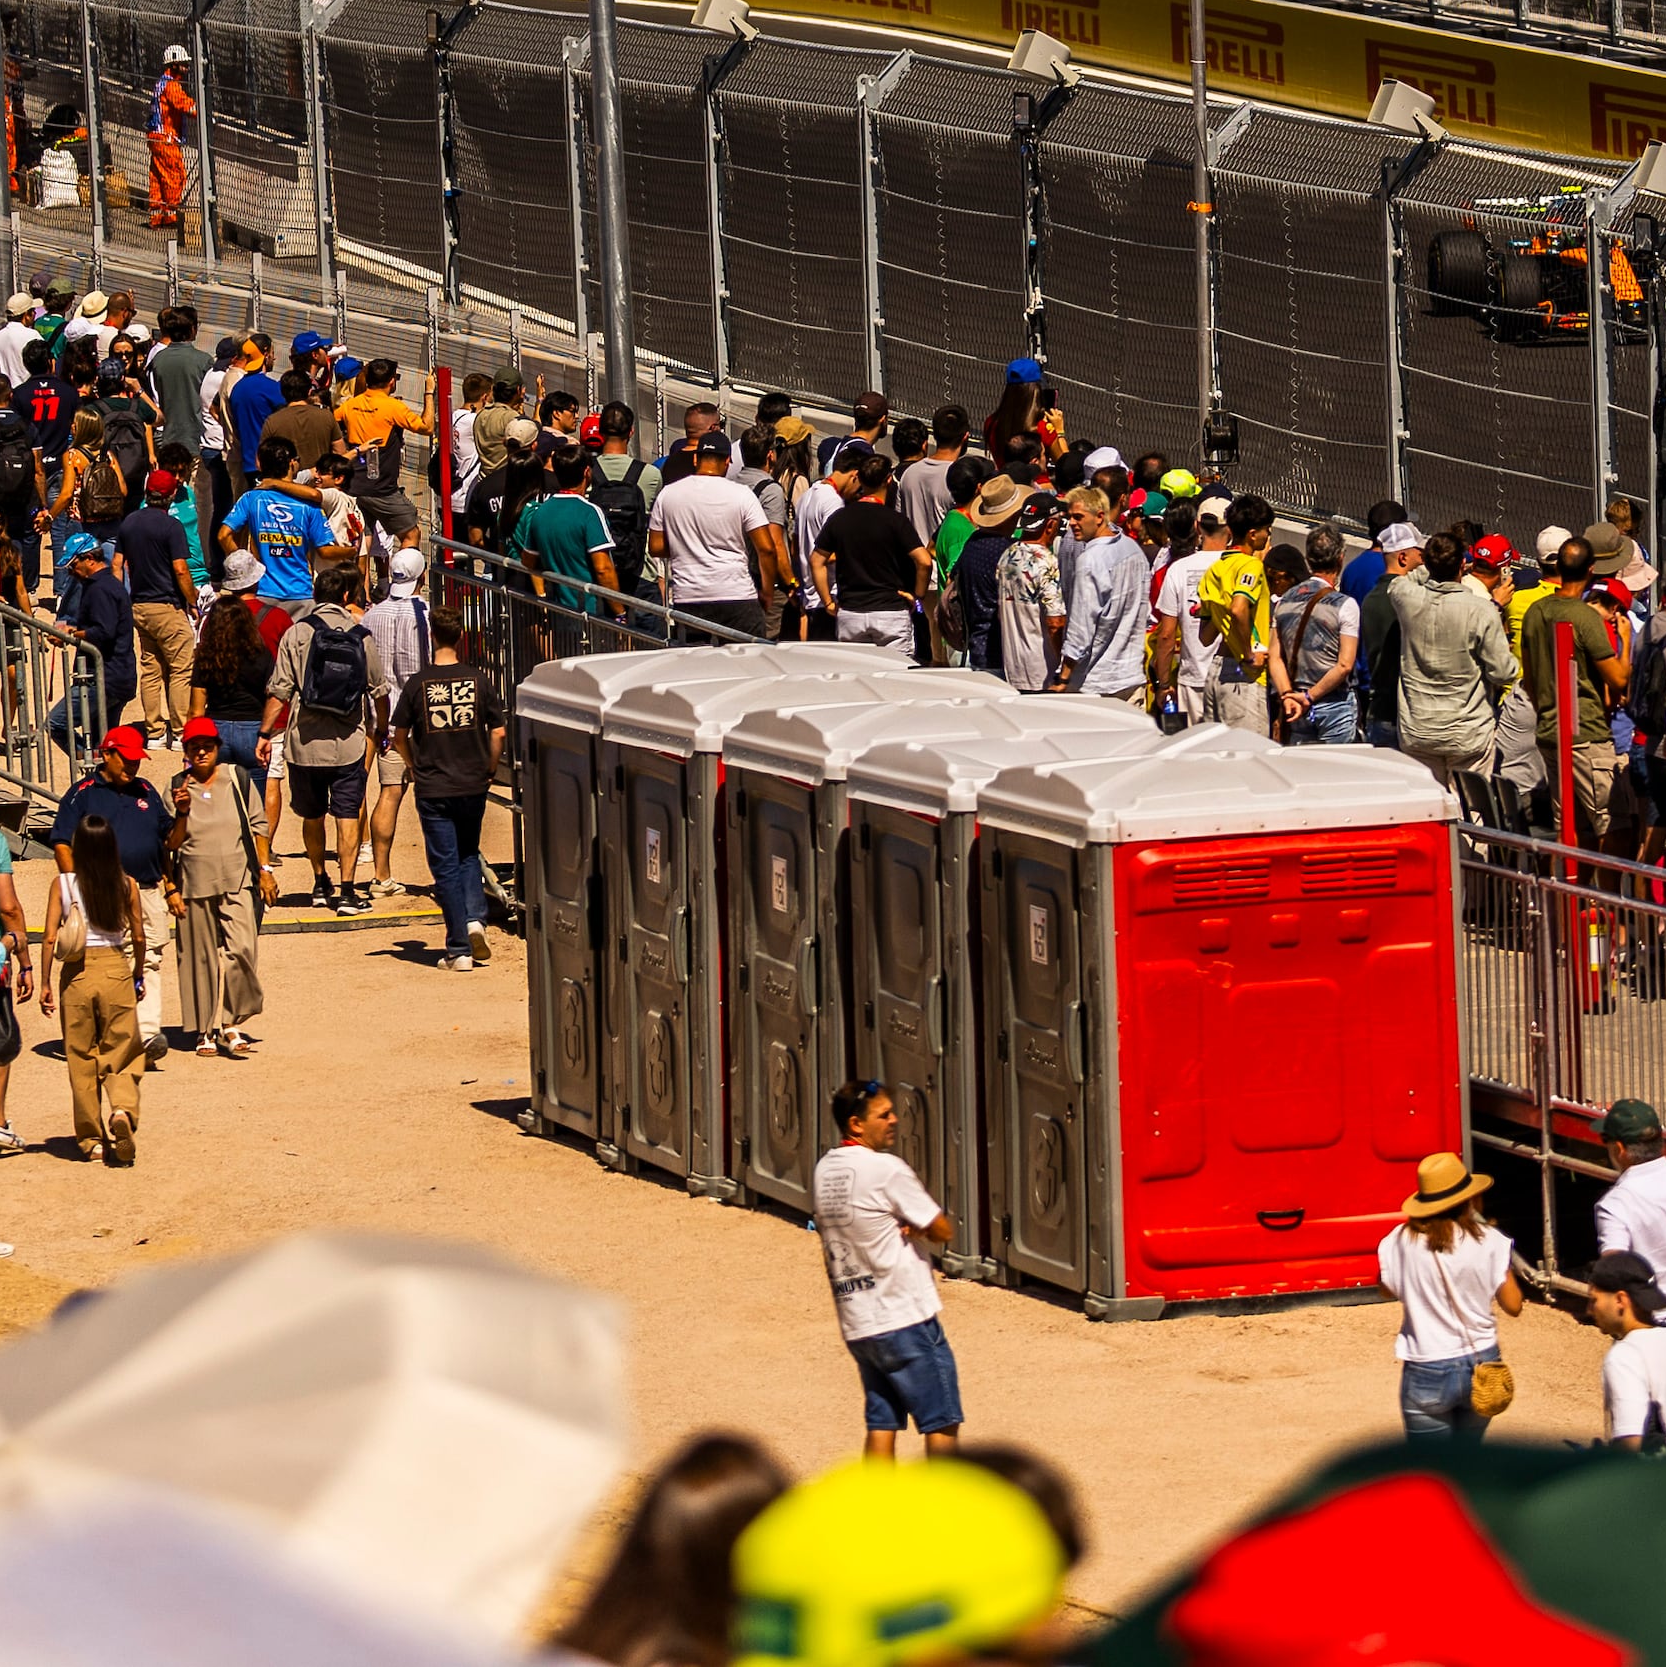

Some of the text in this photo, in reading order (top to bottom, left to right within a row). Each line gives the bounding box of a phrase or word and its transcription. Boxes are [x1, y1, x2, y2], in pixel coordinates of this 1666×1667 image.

[1171, 2, 1285, 85] PRELLI
[1365, 38, 1496, 127] PELLI
[31, 397, 60, 421] 11
[261, 533, 301, 546] RENAULT
[833, 1276, 875, 1295] NUTS
